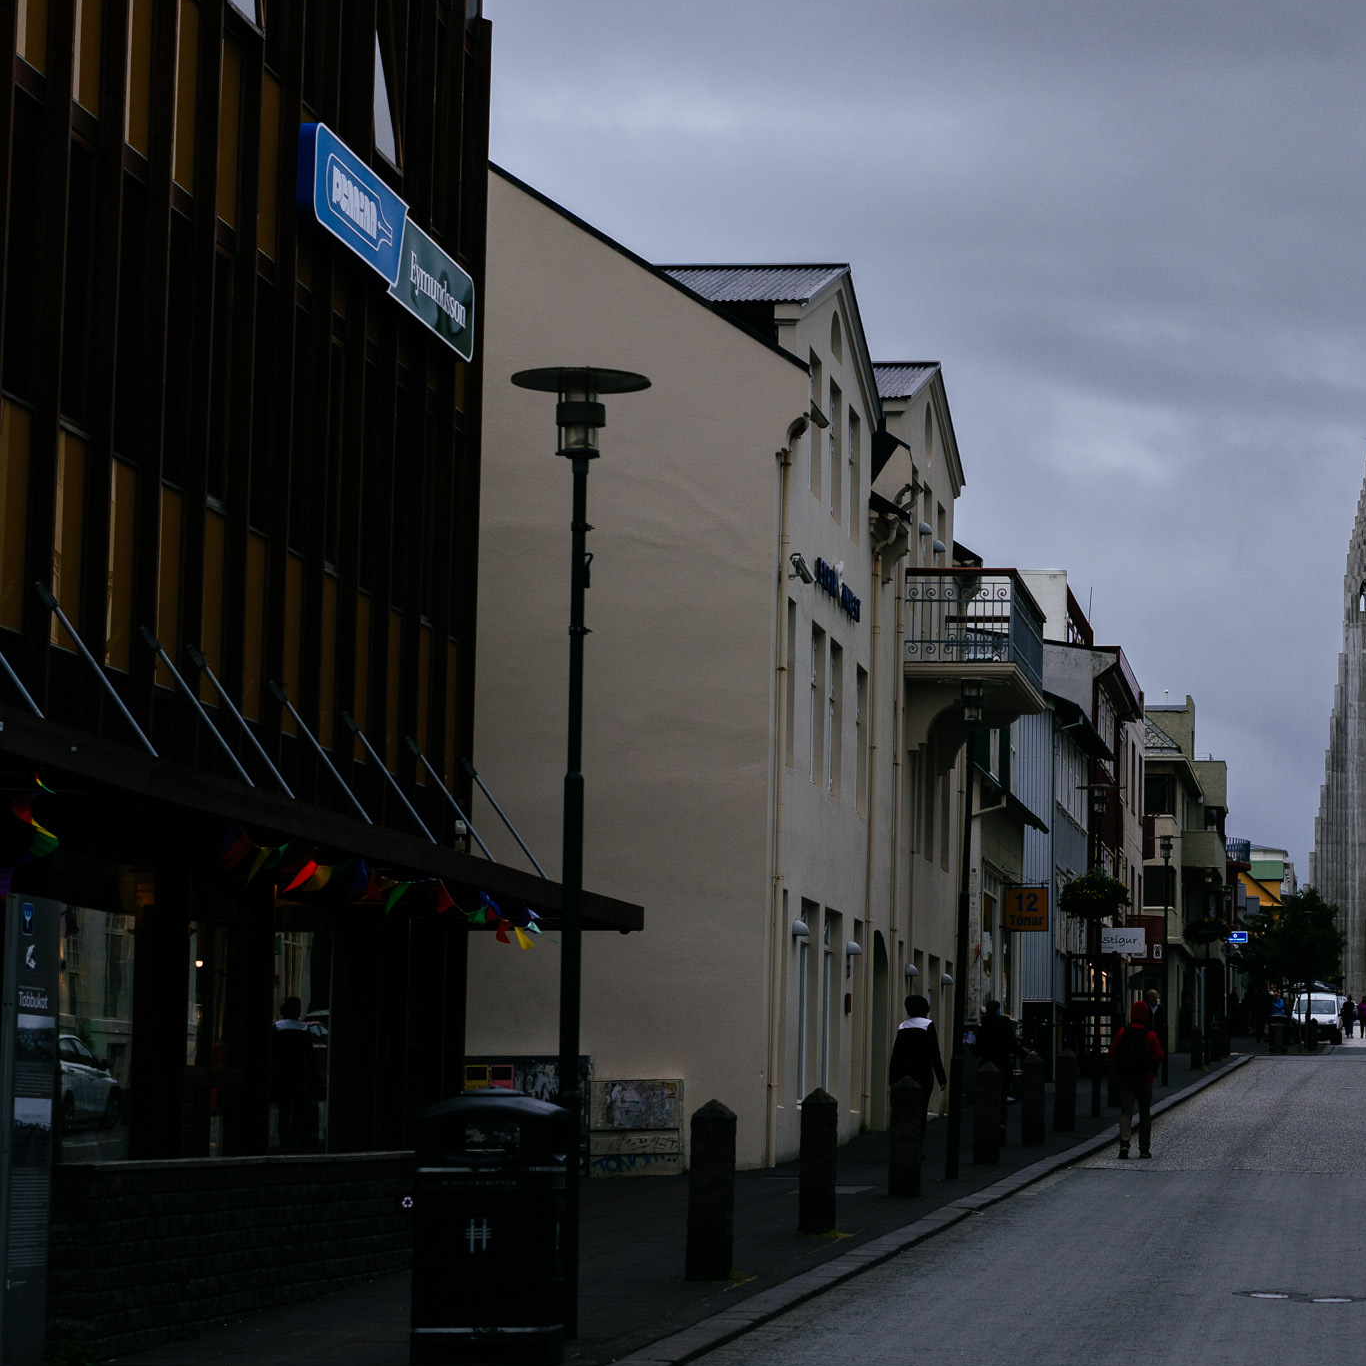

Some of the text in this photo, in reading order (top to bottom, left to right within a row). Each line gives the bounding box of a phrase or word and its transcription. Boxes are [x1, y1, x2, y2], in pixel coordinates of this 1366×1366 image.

[410, 250, 467, 329] Eymundsson
[1015, 893, 1038, 912] 12
[1009, 914, 1044, 926] Tónar
[1101, 935, 1138, 946] Stígur
